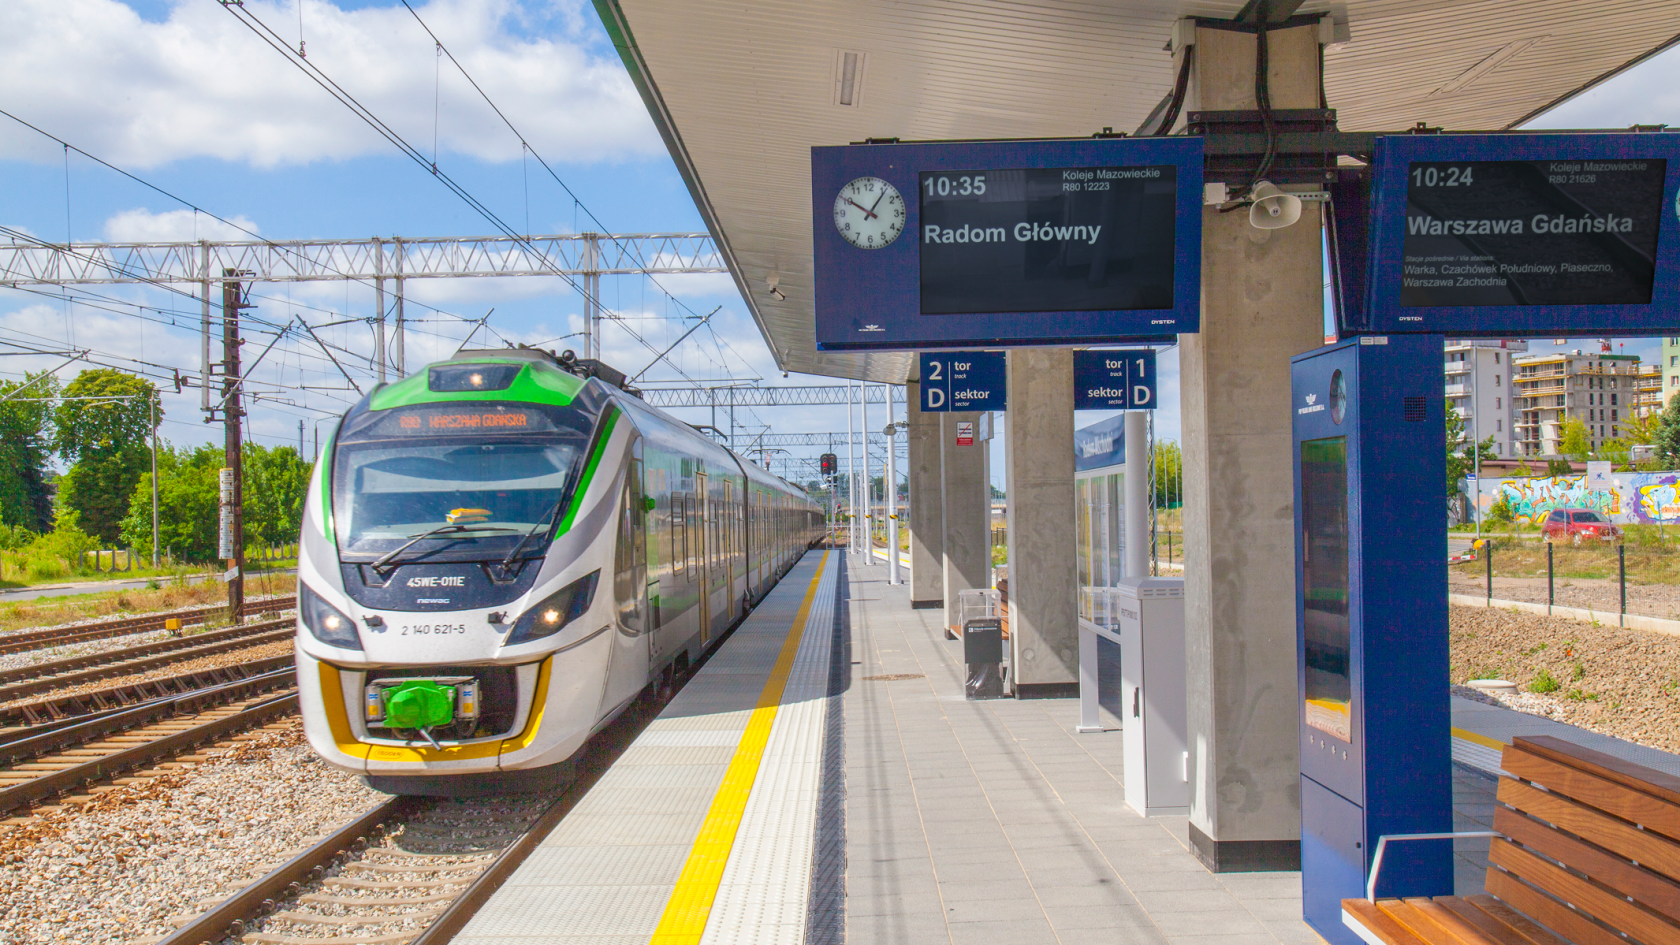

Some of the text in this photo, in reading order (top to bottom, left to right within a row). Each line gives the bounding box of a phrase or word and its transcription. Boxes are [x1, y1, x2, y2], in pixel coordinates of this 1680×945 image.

[1550, 161, 1648, 174] Koleje Mazowieckie
[1063, 168, 1160, 182] Koleje Mazowieckie
[1412, 167, 1473, 187] 10:24
[1549, 174, 1596, 184] R80 21626
[852, 187, 860, 195] 11
[864, 183, 874, 192] 12
[924, 176, 986, 197] 10:35
[1062, 182, 1110, 192] R80 12223
[889, 196, 895, 204] 2
[840, 209, 846, 218] 9
[894, 209, 900, 217] 3
[844, 222, 850, 231] 8
[1408, 214, 1632, 236] Warszawa Gdańska
[855, 232, 860, 240] 7
[868, 235, 873, 243] 6
[880, 232, 886, 240] 5
[924, 221, 1102, 246] Radom Główny
[1404, 263, 1614, 275] Warka, Czachówek Południowy, Piaseczno,
[1404, 277, 1507, 287] Warszawa Zachodnia
[954, 361, 971, 370] tor
[1106, 359, 1122, 369] tor
[1136, 358, 1144, 377] 1
[929, 361, 942, 380] 2
[954, 388, 990, 399] sektor
[1088, 386, 1123, 397] sektor
[1134, 385, 1150, 405] D
[928, 388, 945, 407] D
[429, 414, 480, 428] WARSZAWA
[406, 576, 465, 587] 45WE-011E
[401, 624, 465, 635] 2 140 621-5
